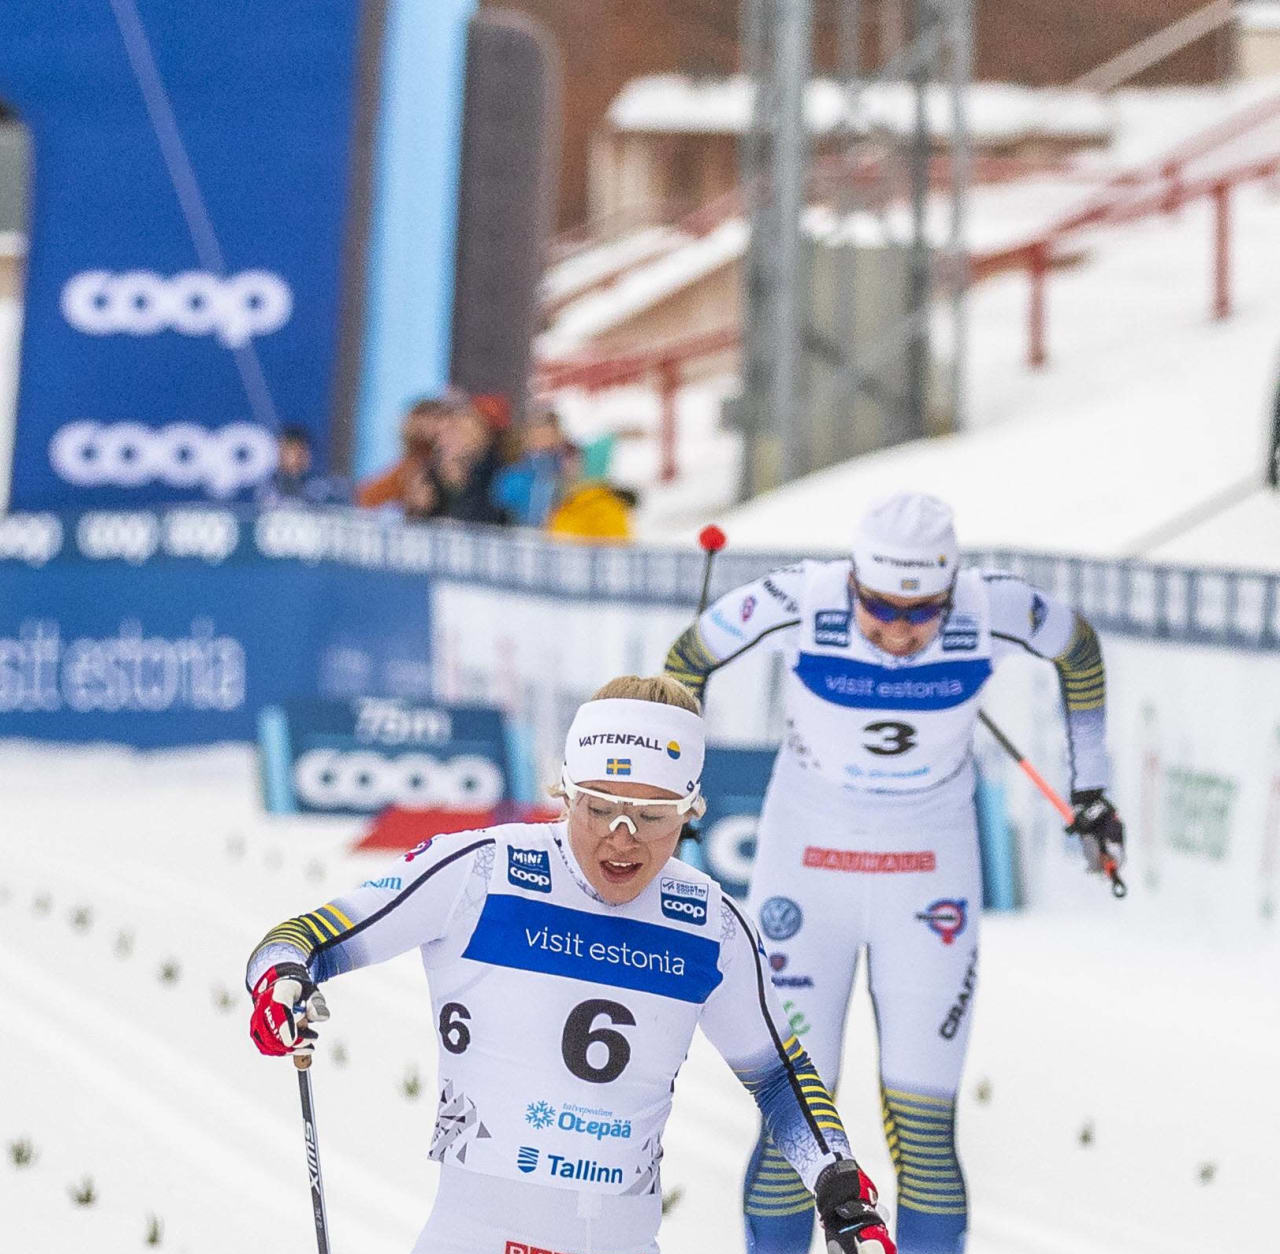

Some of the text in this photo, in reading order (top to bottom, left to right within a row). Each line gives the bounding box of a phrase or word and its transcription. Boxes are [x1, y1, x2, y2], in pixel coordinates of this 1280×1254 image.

[60, 268, 292, 349] coop
[48, 419, 278, 498] coop
[825, 674, 963, 698] visit estonia
[579, 733, 662, 751] VATTENFALL
[862, 720, 916, 756] 3
[510, 867, 550, 886] coop
[663, 899, 705, 918] coop
[525, 926, 686, 976] visit estonia
[439, 1001, 472, 1055] 6
[561, 998, 637, 1084] 6
[557, 1110, 632, 1141] Otepää
[304, 1121, 321, 1196] SWIX
[547, 1153, 624, 1184] Tallinn
